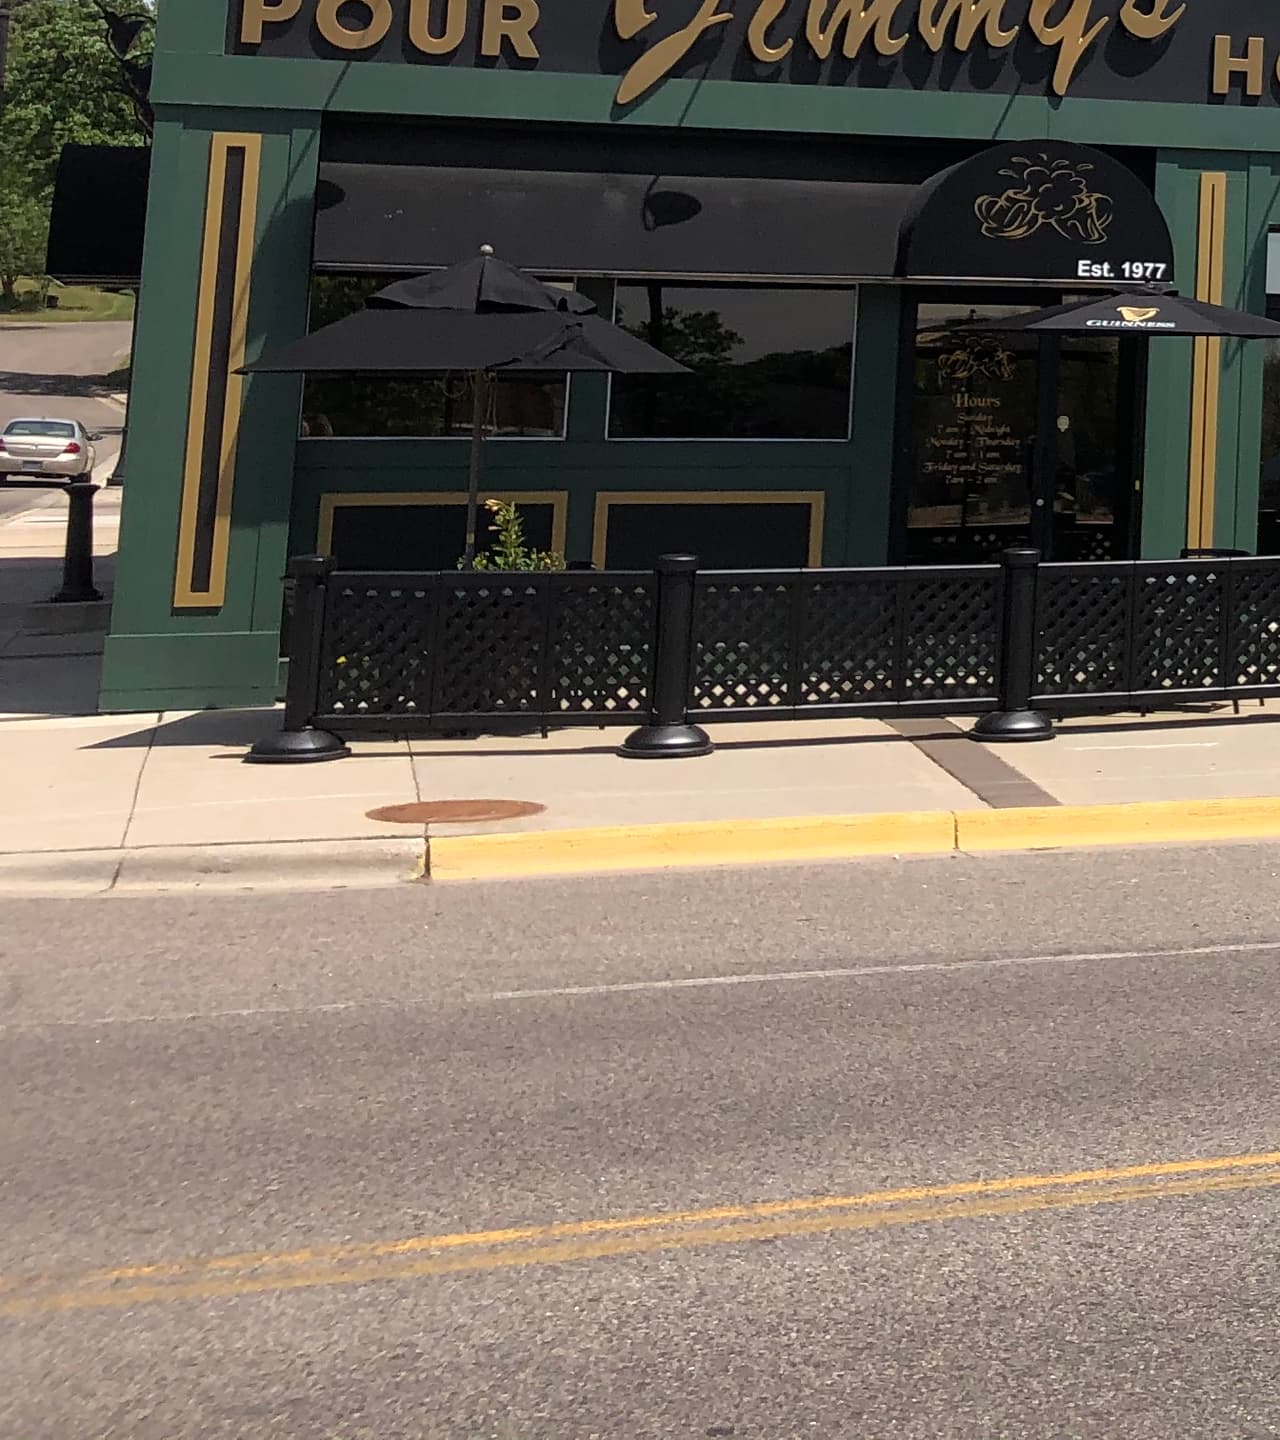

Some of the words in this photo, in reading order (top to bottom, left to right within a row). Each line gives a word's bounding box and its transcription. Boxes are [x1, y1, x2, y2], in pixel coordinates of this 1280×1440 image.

[1077, 259, 1116, 279] Est.
[1121, 260, 1167, 280] 1977
[1085, 319, 1176, 328] GUINNESS
[951, 392, 1001, 408] Hours
